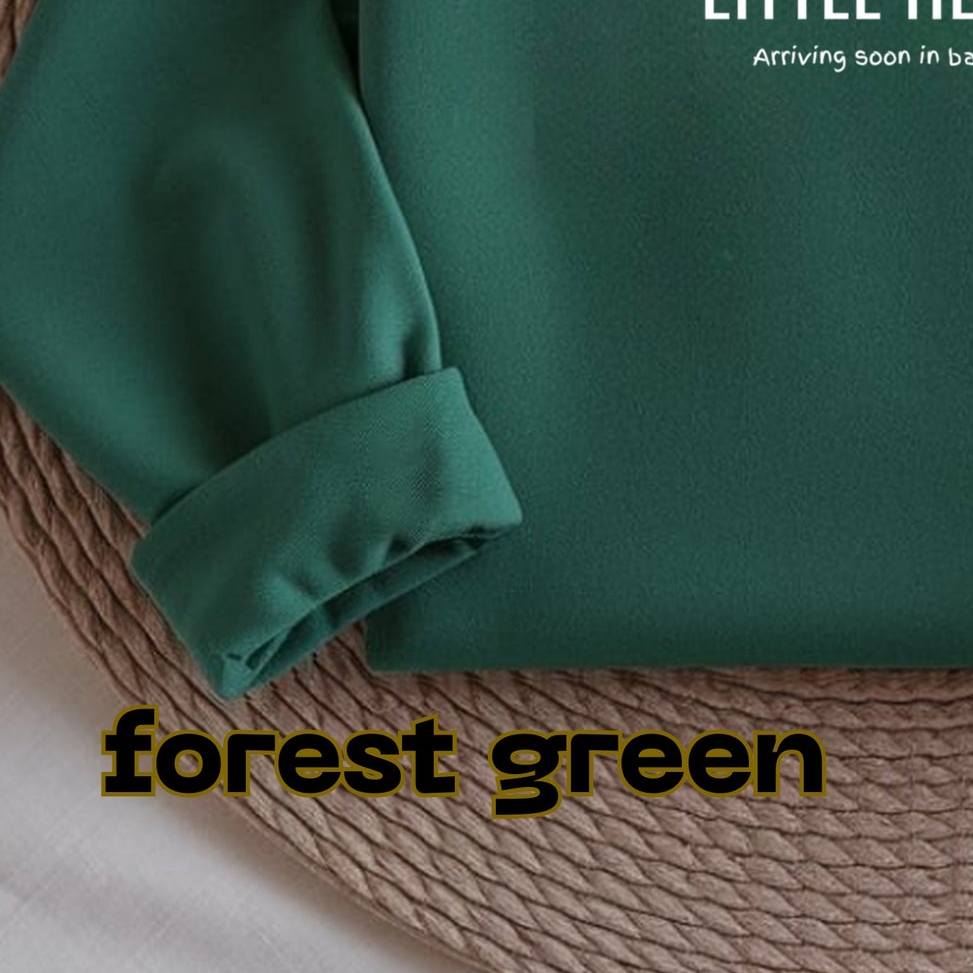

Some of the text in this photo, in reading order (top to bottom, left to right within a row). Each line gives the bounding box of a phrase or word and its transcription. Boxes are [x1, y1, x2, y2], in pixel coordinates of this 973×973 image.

[752, 44, 847, 73] Arriving
[854, 49, 911, 66] soon
[919, 44, 940, 65] in
